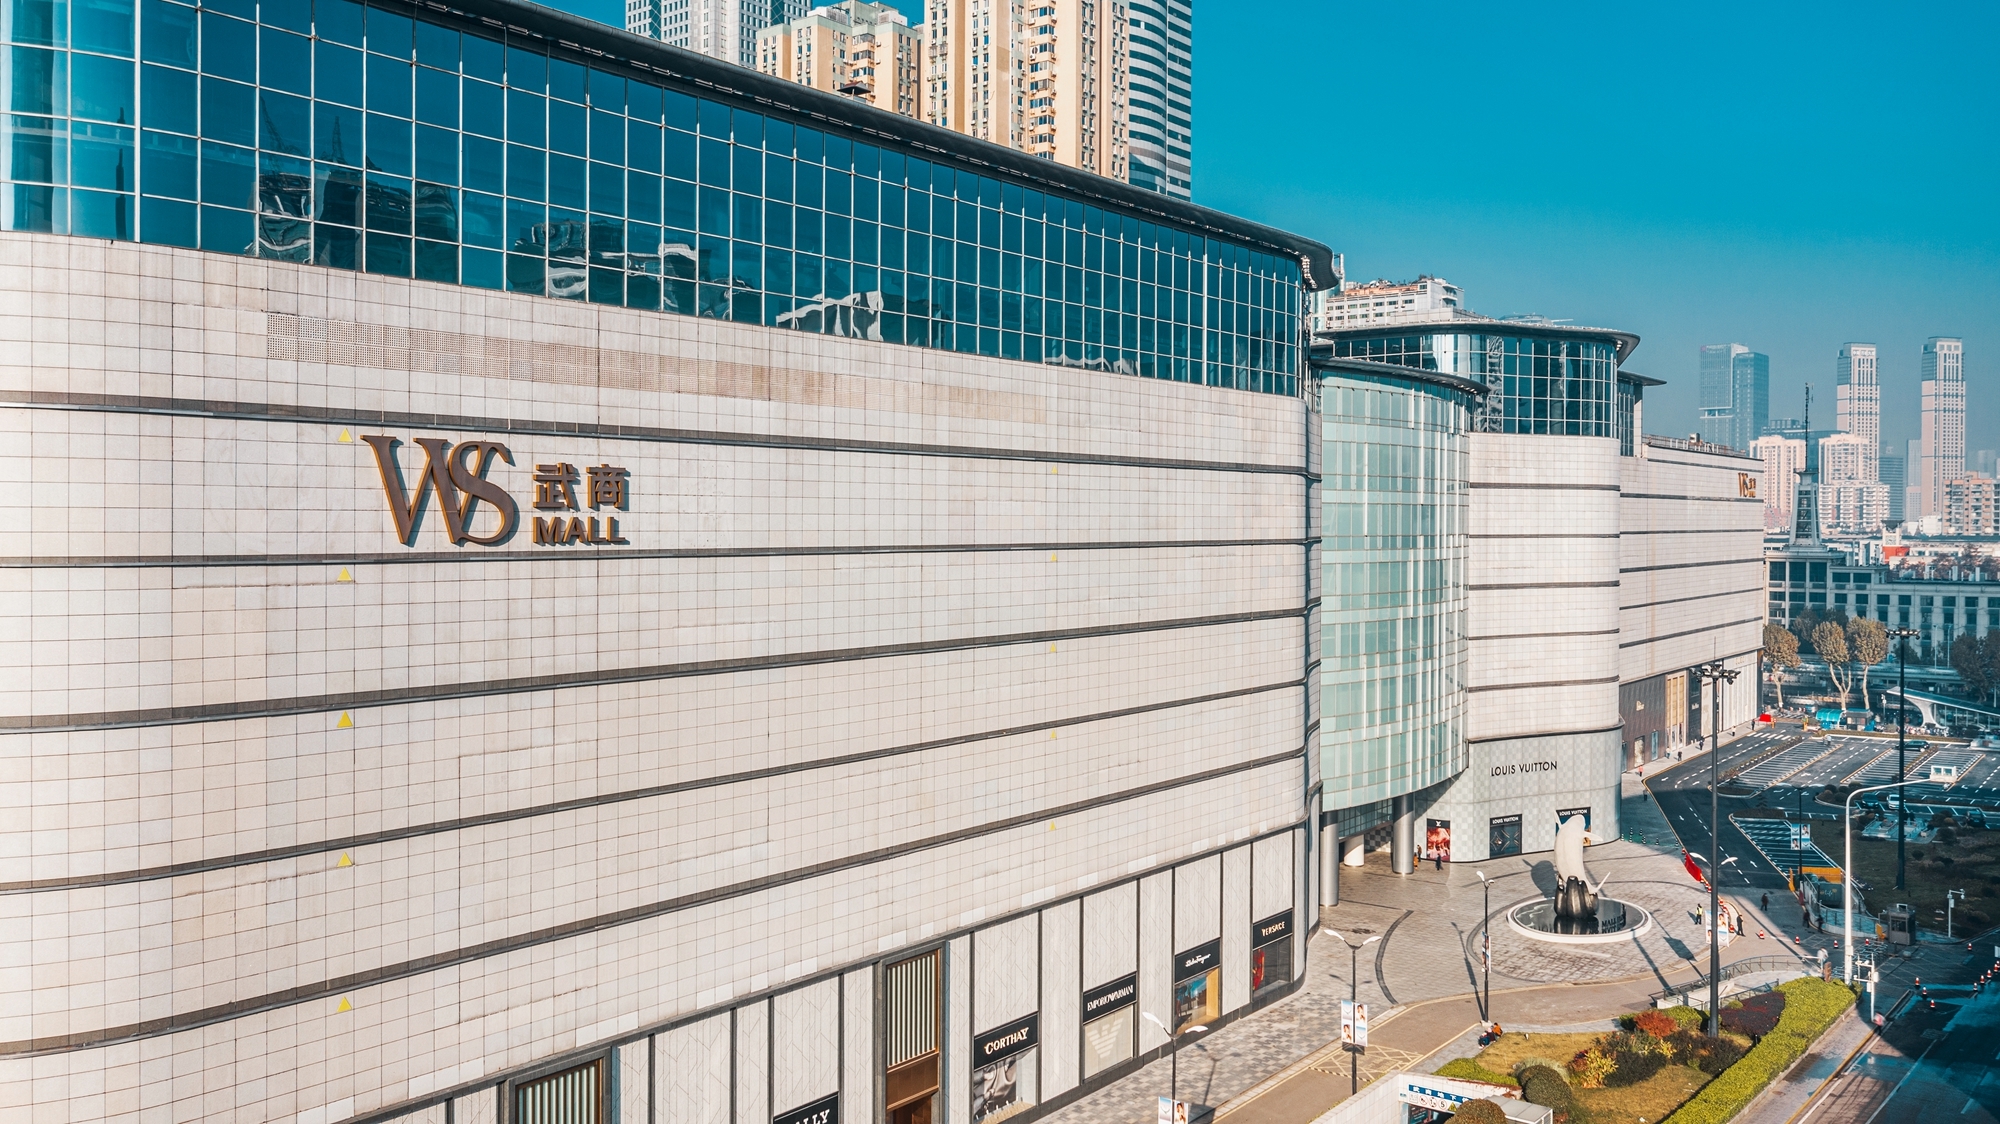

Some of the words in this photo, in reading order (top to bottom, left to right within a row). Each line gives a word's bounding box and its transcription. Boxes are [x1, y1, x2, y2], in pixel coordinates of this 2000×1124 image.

[360, 435, 515, 545] WS
[533, 462, 627, 510] 武商
[533, 516, 626, 544] MALL
[1490, 765, 1516, 777] LOUIS
[1519, 761, 1557, 774] VUITTON
[1261, 921, 1285, 936] VERSACE
[984, 1027, 1029, 1055] CORTHAY
